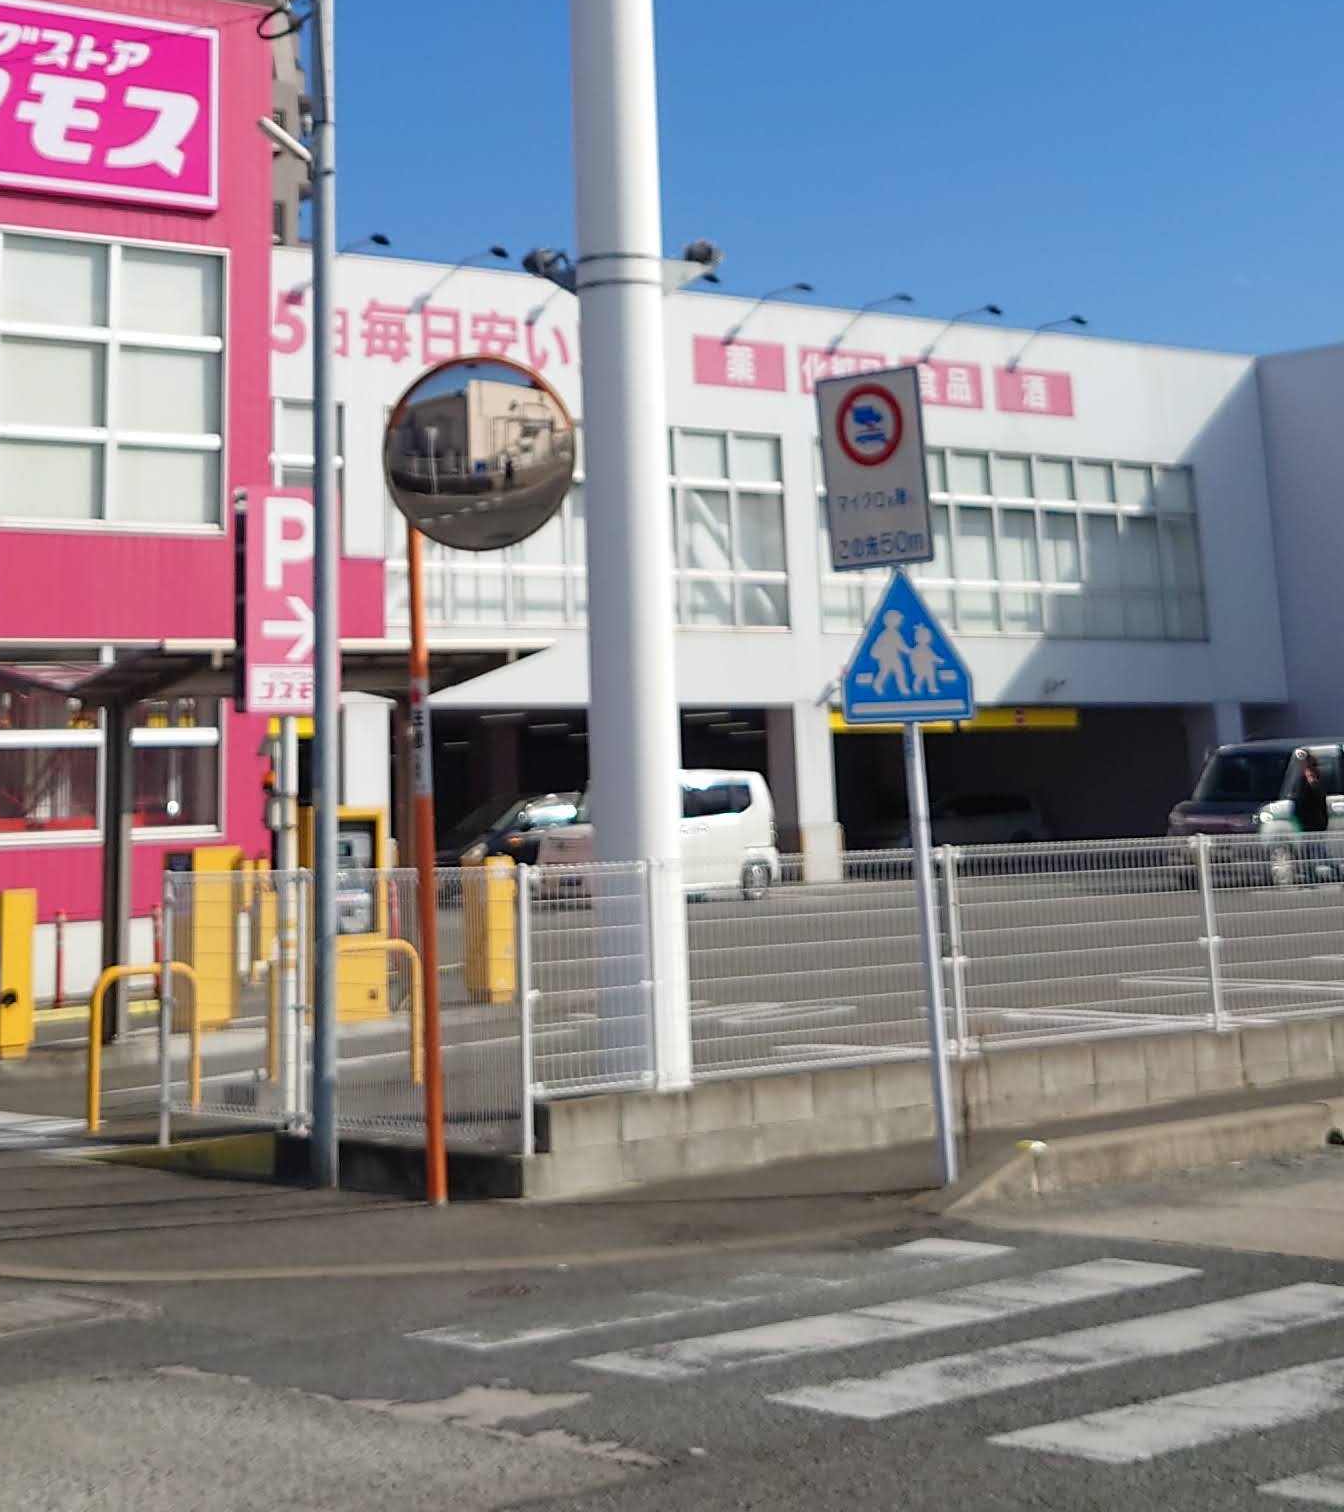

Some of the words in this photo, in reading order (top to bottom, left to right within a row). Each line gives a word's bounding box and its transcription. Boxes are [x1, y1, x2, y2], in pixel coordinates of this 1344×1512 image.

[264, 496, 315, 590] P
[256, 680, 314, 700] コスモ
